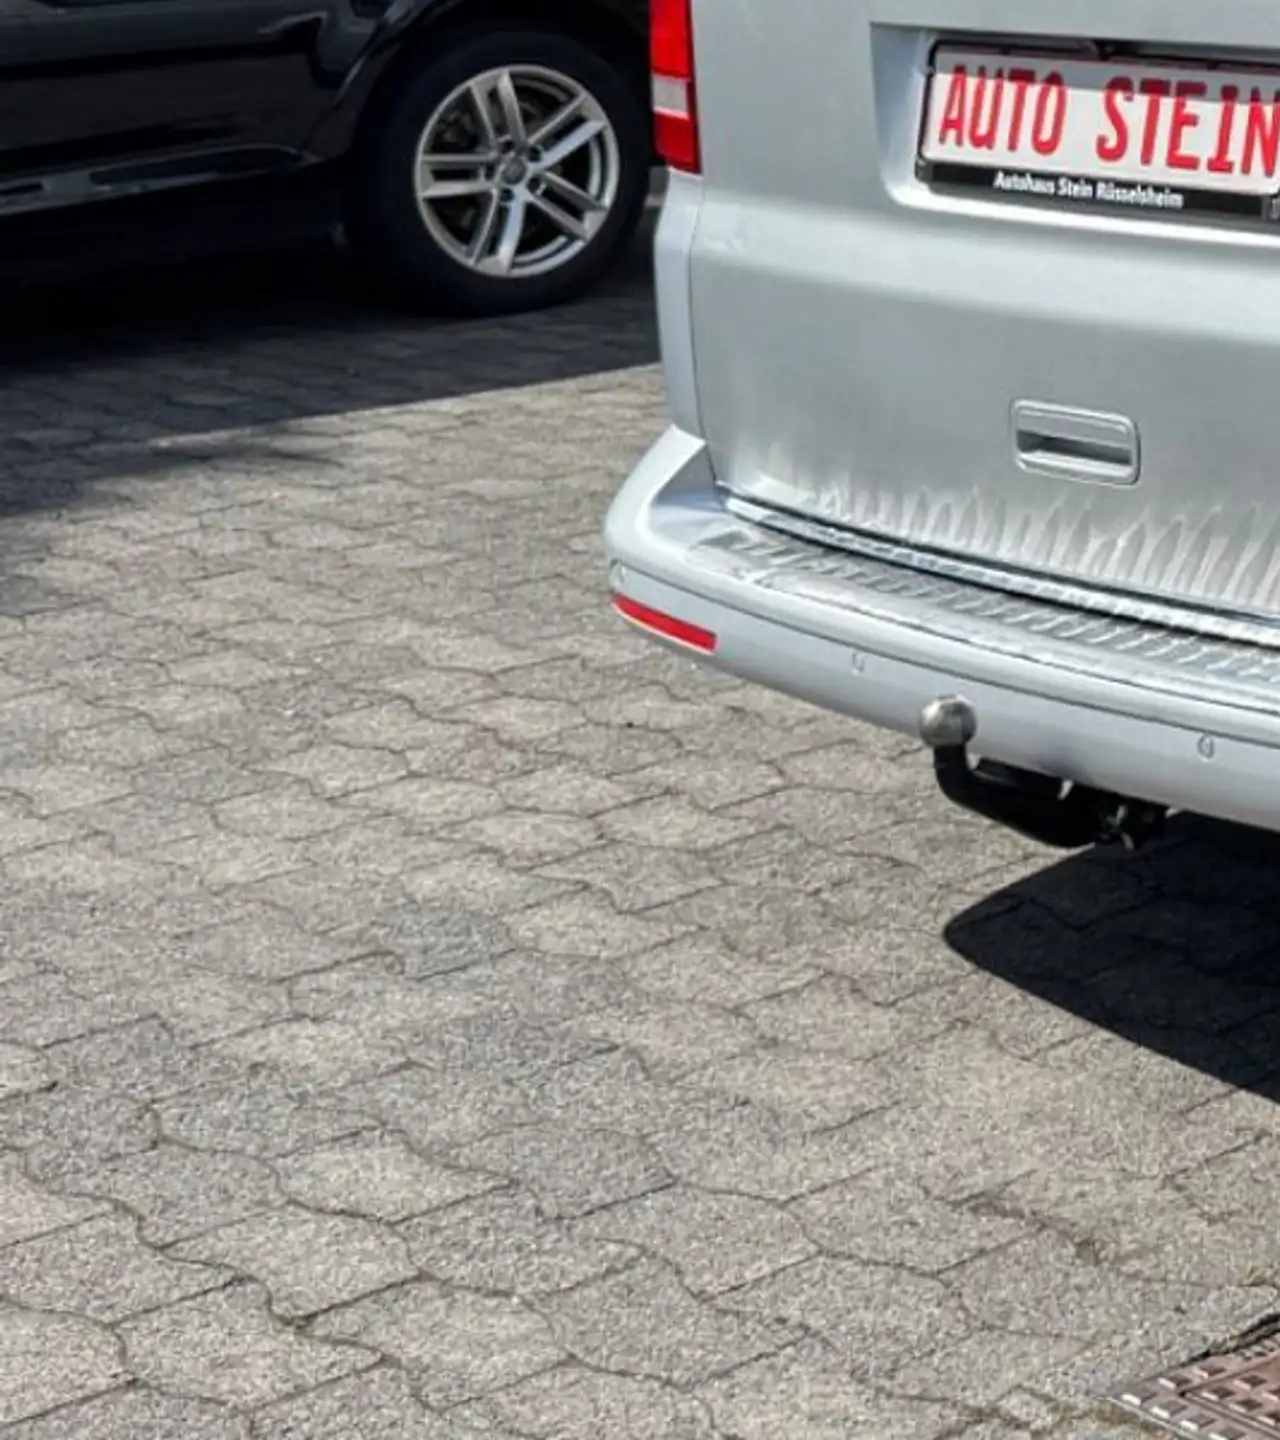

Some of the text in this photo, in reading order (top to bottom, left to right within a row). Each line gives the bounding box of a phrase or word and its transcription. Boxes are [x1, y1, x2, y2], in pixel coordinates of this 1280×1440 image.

[938, 64, 1070, 158] AUTO
[993, 170, 1186, 210] Autohaus Stein Rüsselsheim
